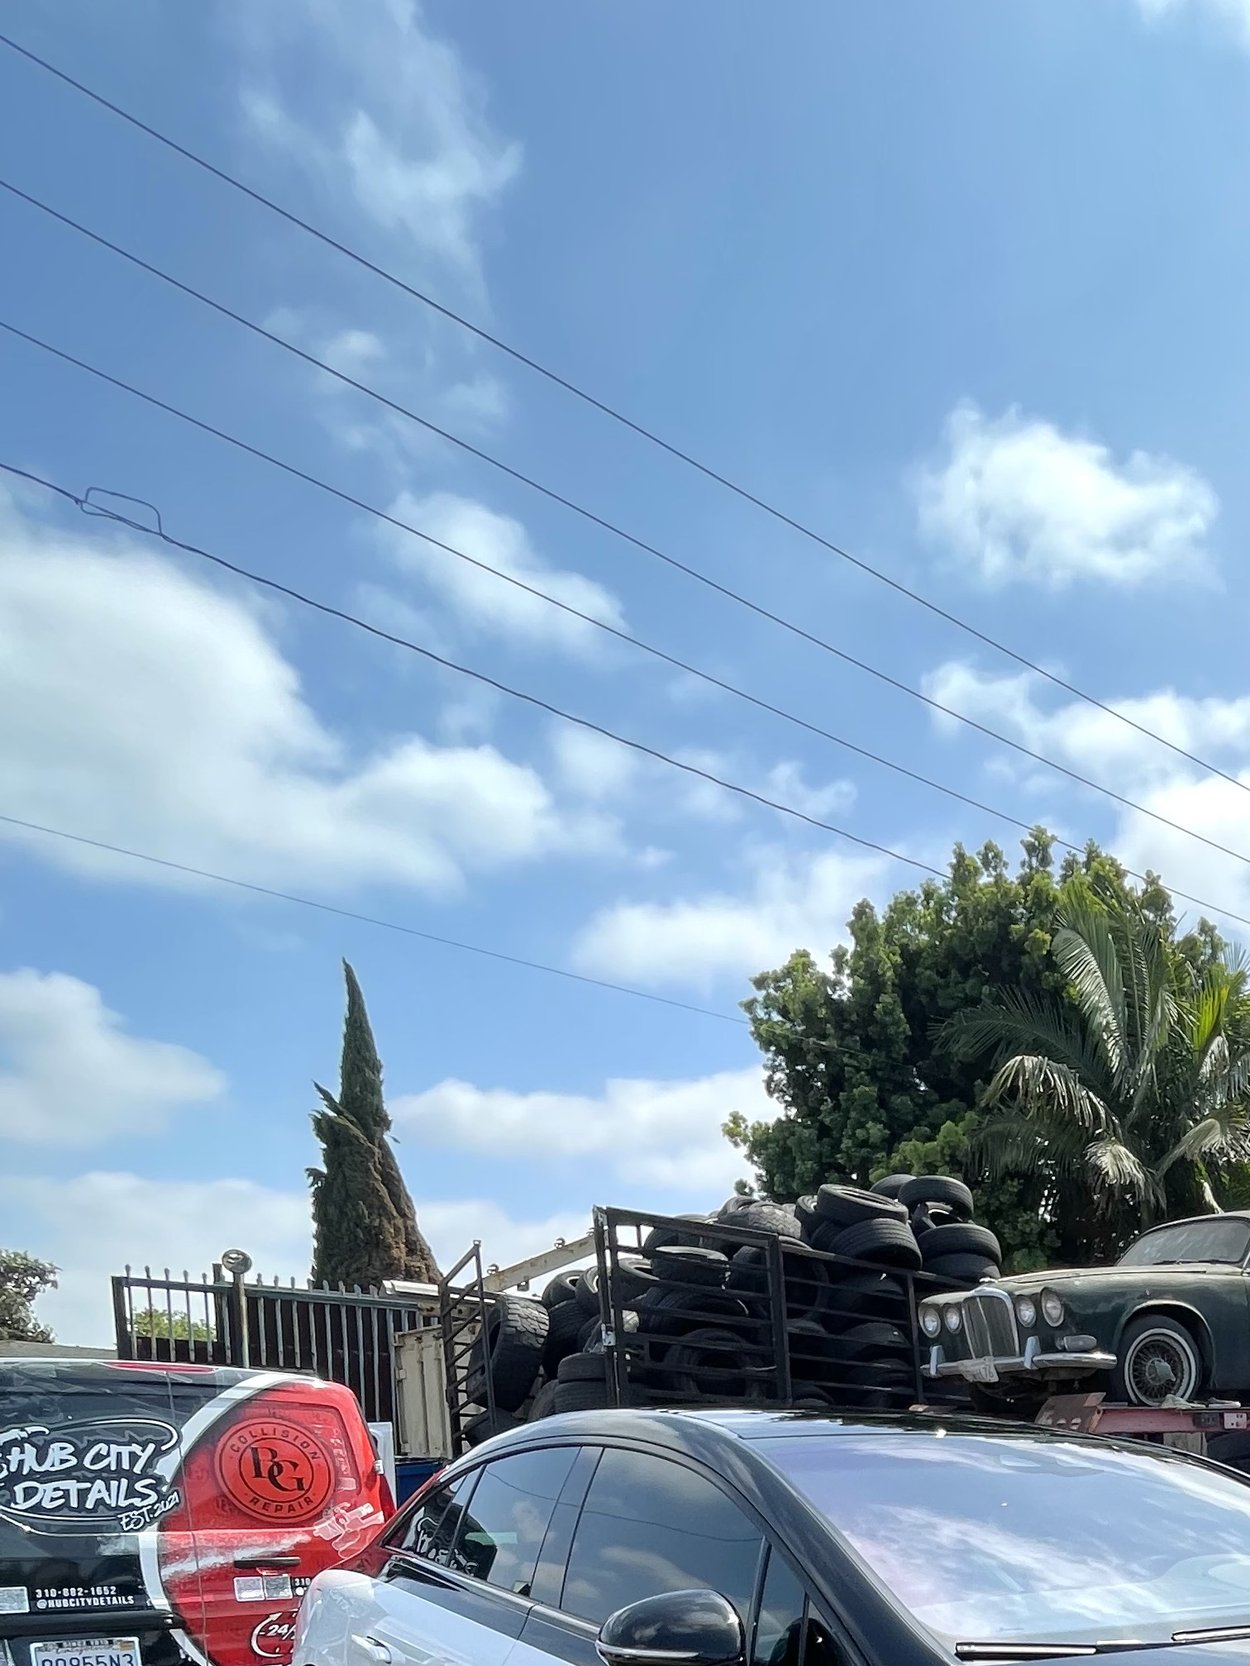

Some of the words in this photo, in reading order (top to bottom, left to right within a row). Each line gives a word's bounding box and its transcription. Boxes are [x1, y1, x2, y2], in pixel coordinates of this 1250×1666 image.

[6, 1442, 79, 1475] HUB
[83, 1442, 157, 1475] CITY
[229, 1427, 321, 1461] COLLISION
[11, 1477, 159, 1510] DETAILS
[248, 1496, 315, 1514] REPAIR
[36, 1595, 135, 1610] @HUBCITYDETAILS
